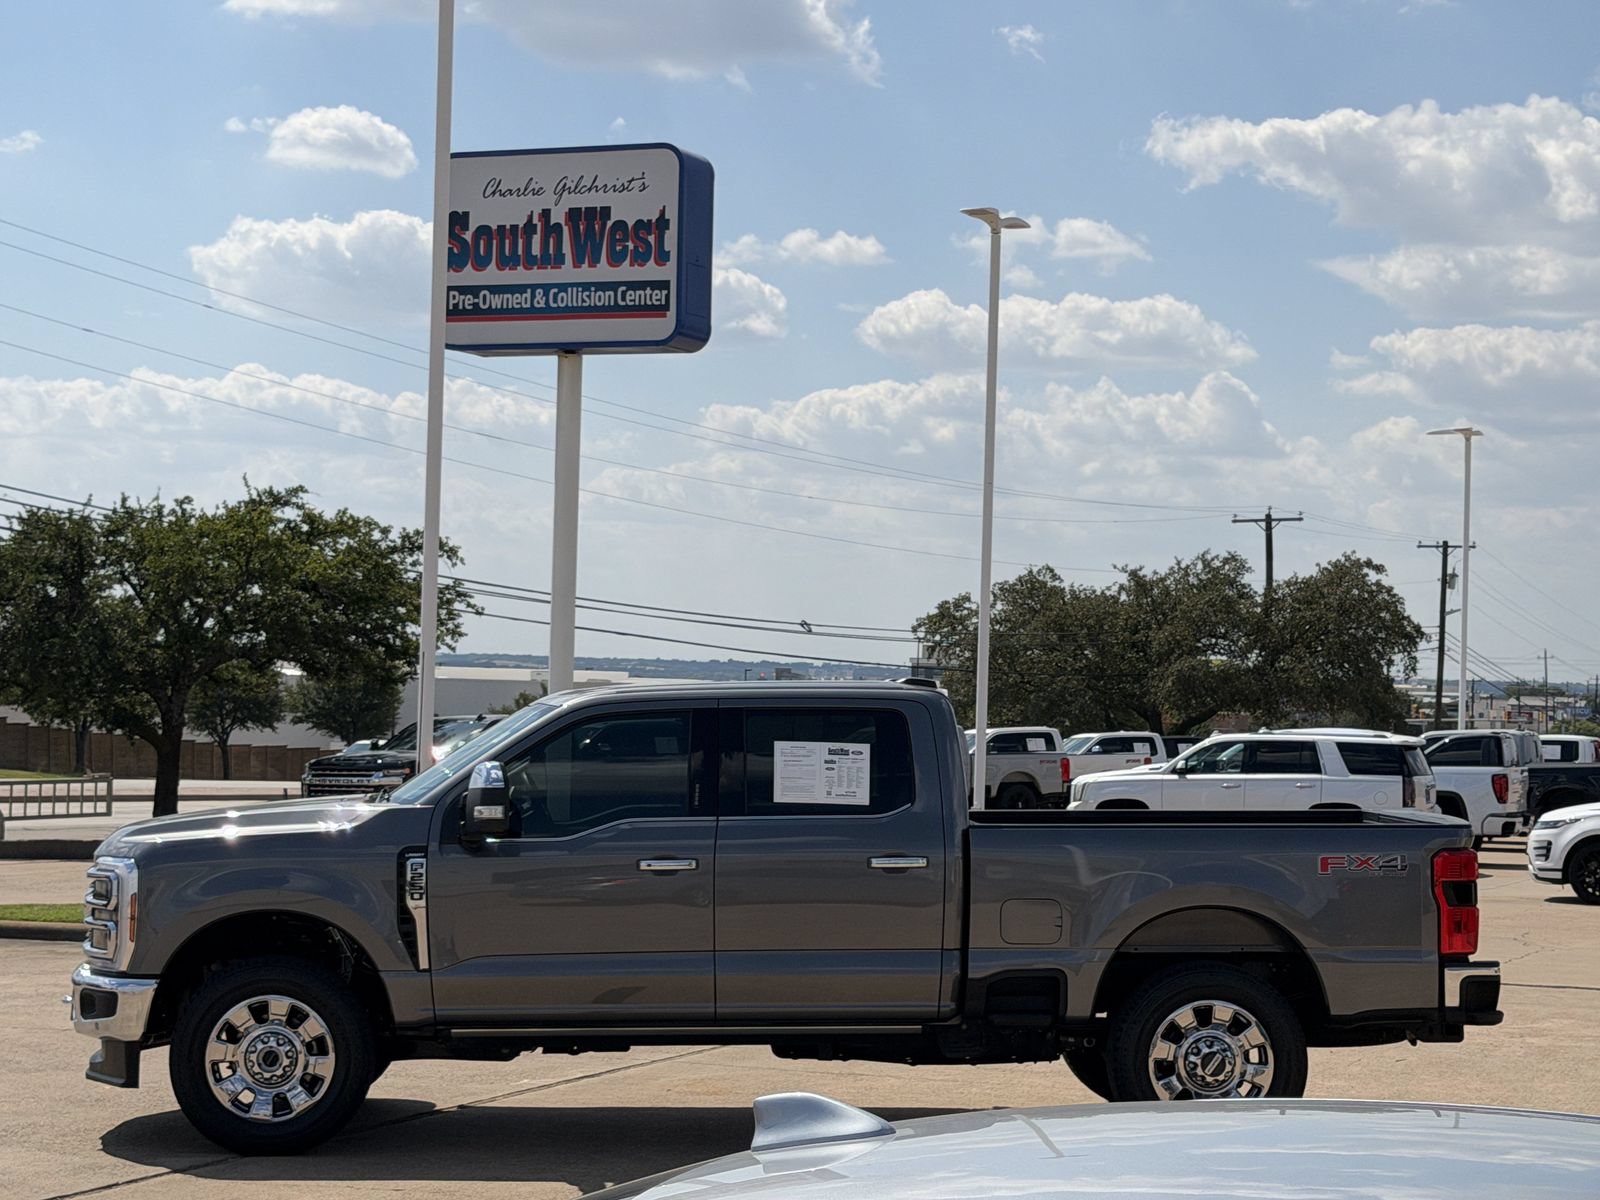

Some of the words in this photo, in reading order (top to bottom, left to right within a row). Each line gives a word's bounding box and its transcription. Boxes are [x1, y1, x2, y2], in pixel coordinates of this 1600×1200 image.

[482, 177, 546, 199] Charlie
[553, 171, 650, 206] Gilchrist's
[448, 288, 531, 310] Pre-Owned
[533, 287, 546, 308] &
[549, 286, 614, 308] Collision
[617, 286, 668, 306] Center
[1318, 854, 1408, 876] FX4
